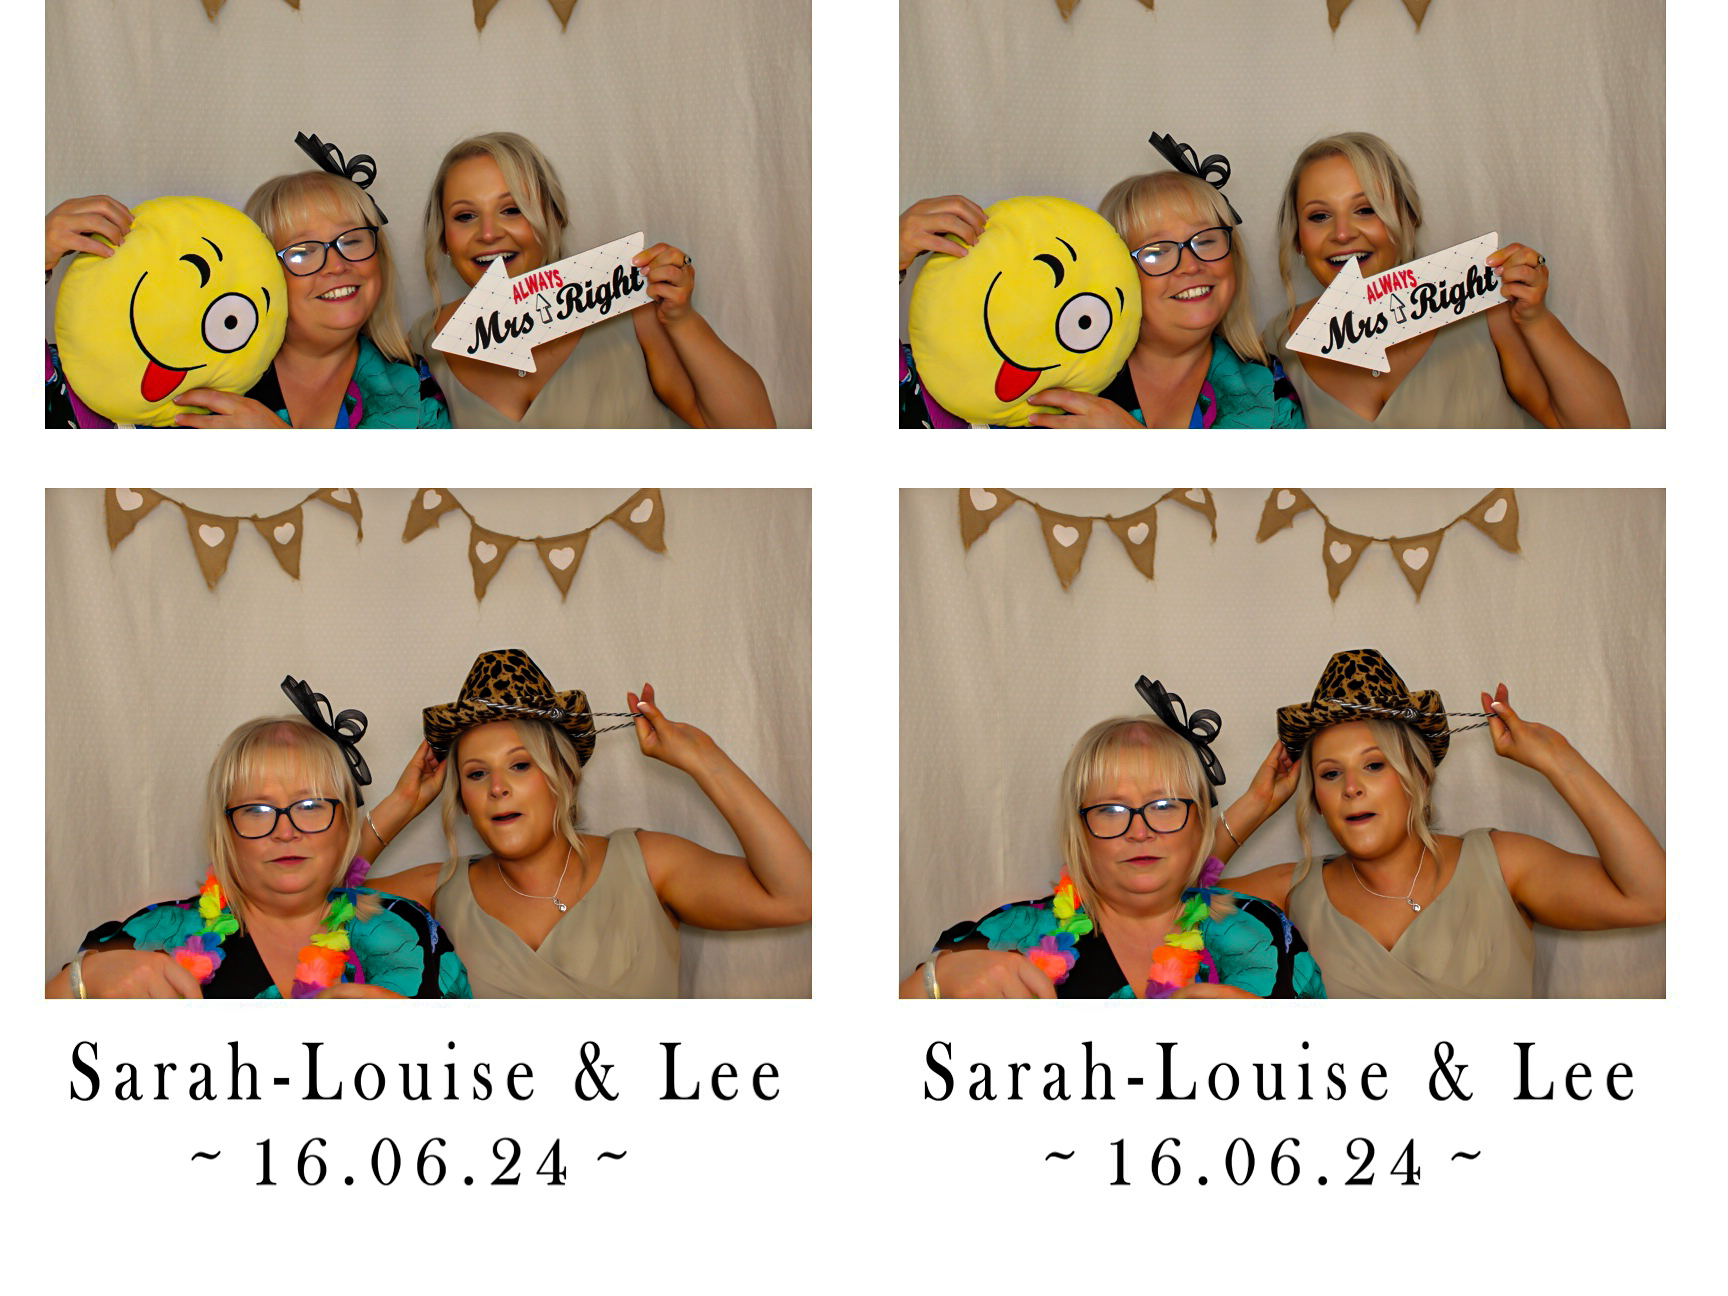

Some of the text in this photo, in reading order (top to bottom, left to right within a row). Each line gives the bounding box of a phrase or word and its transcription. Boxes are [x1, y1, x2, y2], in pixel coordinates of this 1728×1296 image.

[467, 264, 645, 354] Mrs Right
[512, 269, 563, 304] ALWAYS
[1321, 264, 1499, 354] Mrs Right
[1366, 269, 1417, 304] ALWAYS
